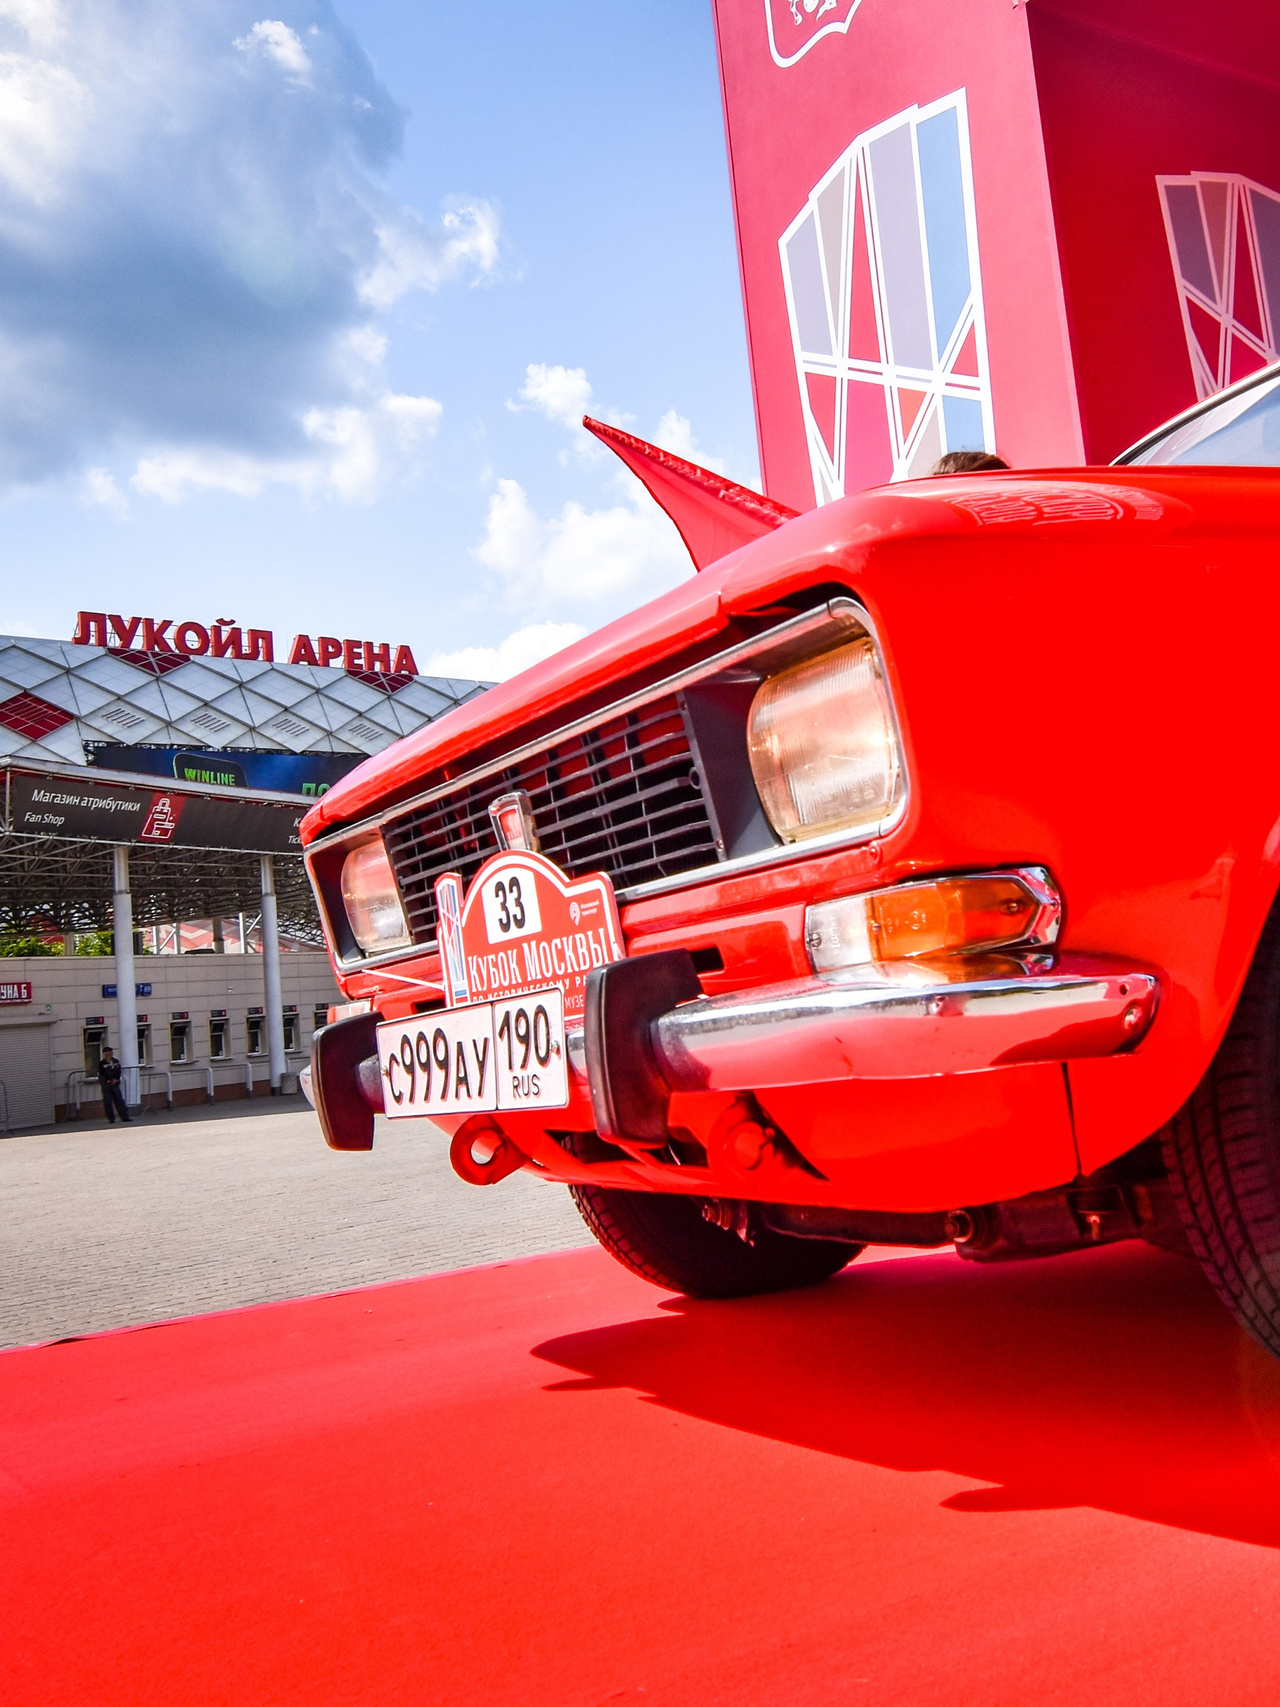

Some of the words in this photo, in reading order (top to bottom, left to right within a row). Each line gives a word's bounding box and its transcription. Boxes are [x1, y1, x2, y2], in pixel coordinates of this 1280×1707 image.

[72, 610, 273, 662] ЛУКОЙЛ
[289, 634, 419, 675] АРЕНА
[31, 789, 80, 806] Магазин
[80, 795, 141, 813] атрибутики
[184, 767, 236, 786] WINLINE
[24, 812, 41, 823] Fan
[42, 813, 65, 827] Shop
[494, 876, 526, 933] 33
[467, 948, 523, 993] КУБОК
[521, 927, 607, 982] МОСКВЫ
[389, 1027, 490, 1104] С999АУ
[498, 1004, 551, 1071] 190
[512, 1074, 541, 1099] RUS
